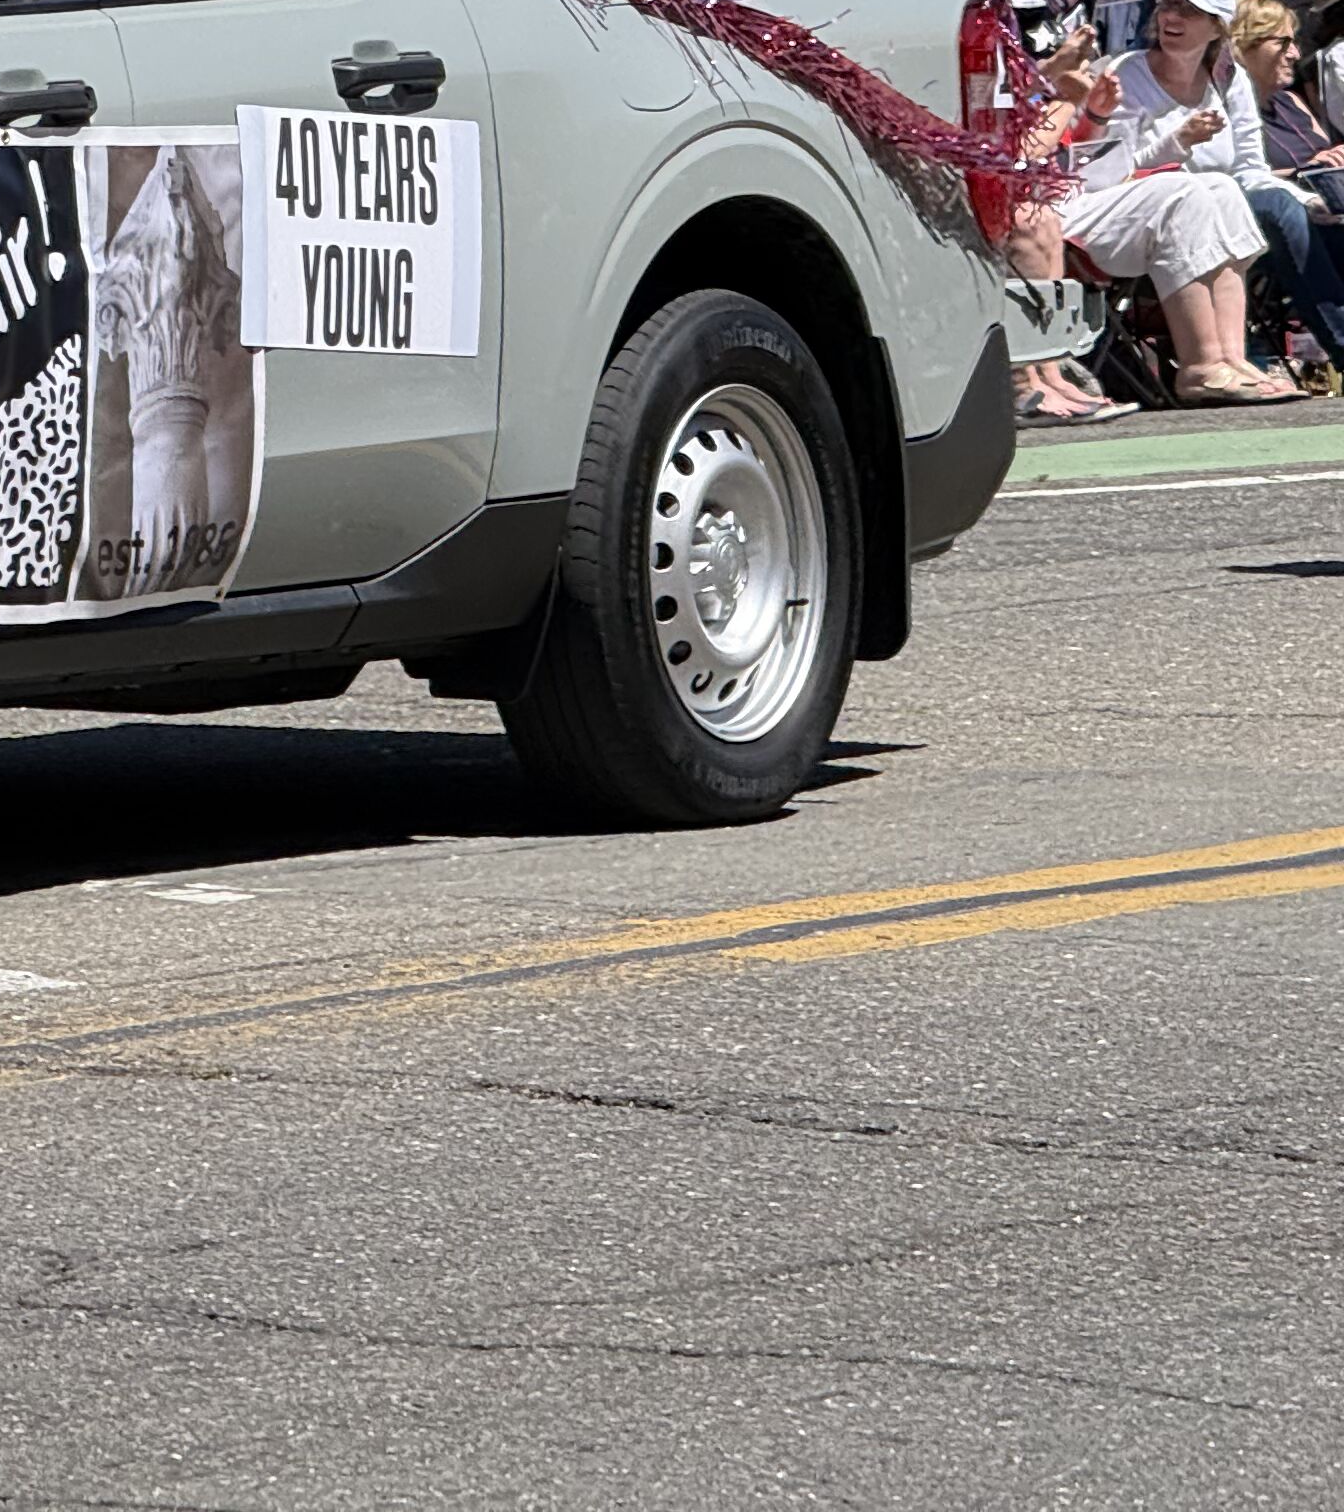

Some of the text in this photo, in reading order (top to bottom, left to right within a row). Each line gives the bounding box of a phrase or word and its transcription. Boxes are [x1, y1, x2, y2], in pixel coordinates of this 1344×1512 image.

[275, 117, 439, 226] 40 YEARS
[301, 243, 414, 350] YOUNG
[97, 530, 151, 577] est.
